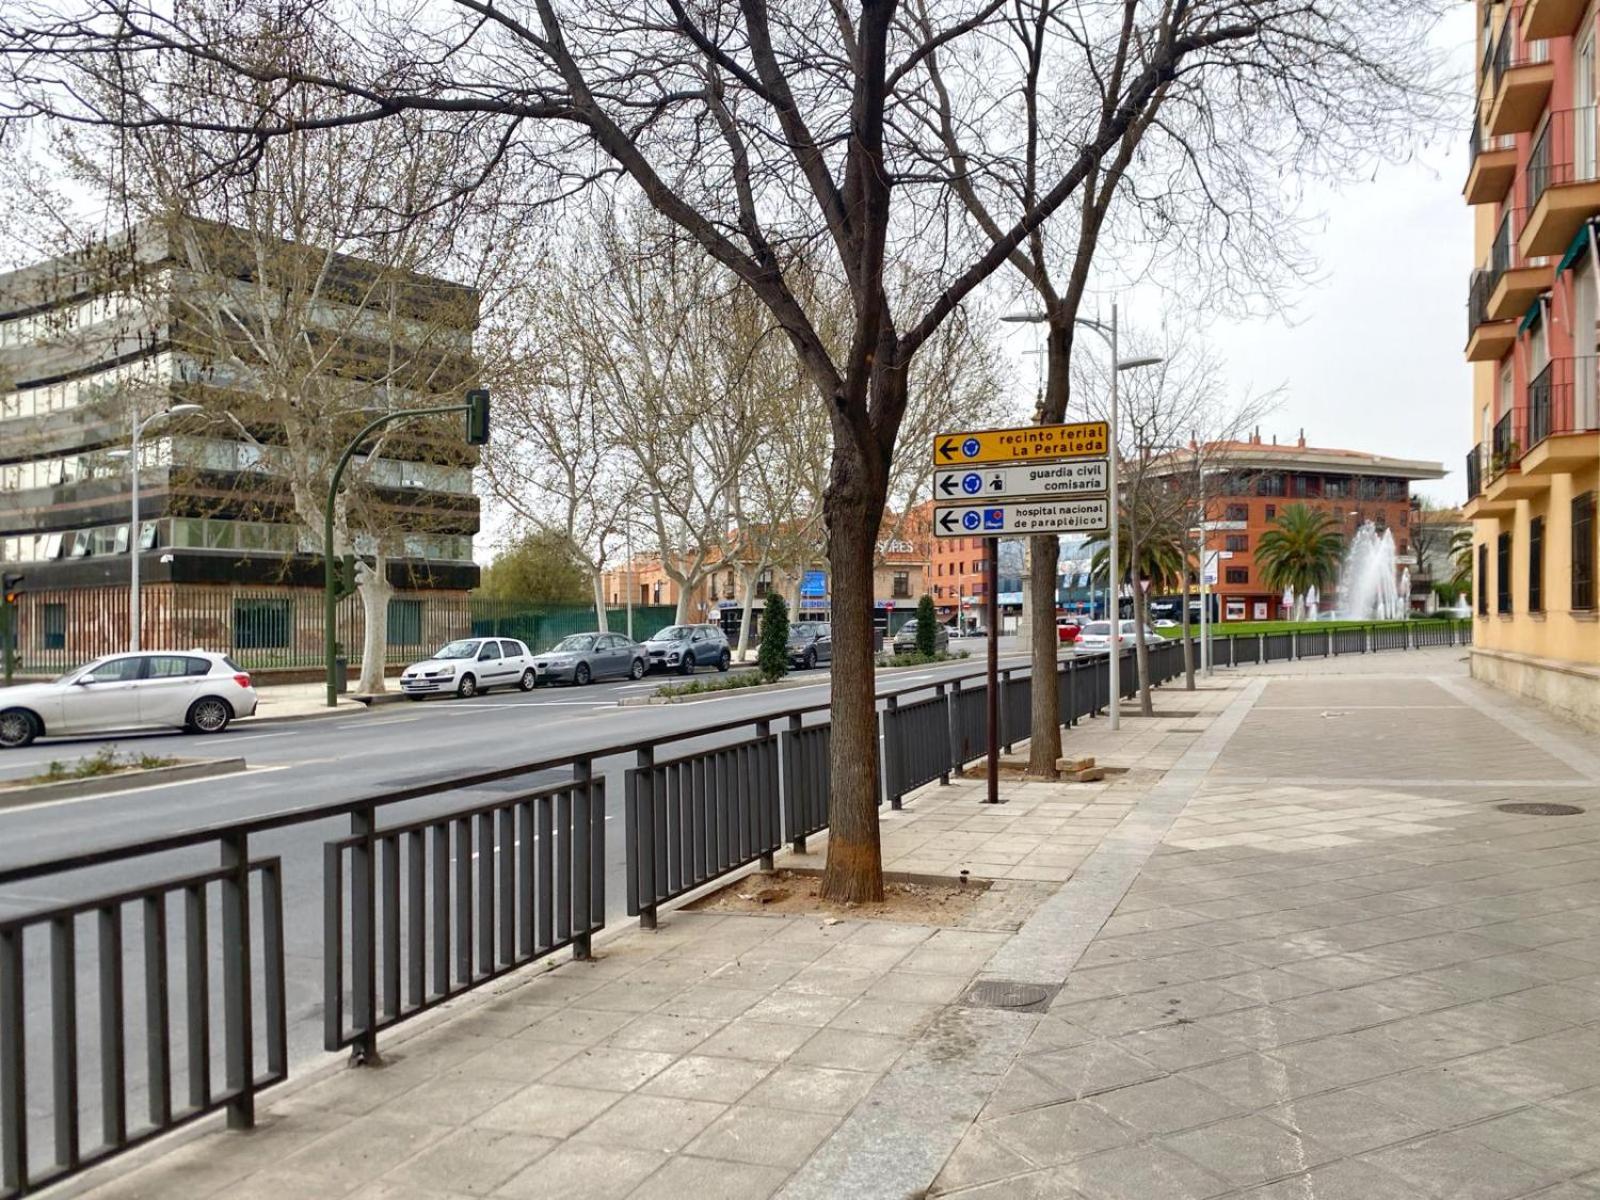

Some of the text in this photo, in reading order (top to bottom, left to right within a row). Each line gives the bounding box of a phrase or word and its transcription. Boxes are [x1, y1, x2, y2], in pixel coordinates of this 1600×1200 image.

[999, 426, 1103, 444] recinto ferial
[1012, 440, 1103, 456] La Peraleda
[1029, 464, 1102, 480] guardia civil
[1015, 503, 1103, 518] hospital nacional
[1014, 519, 1027, 528] de
